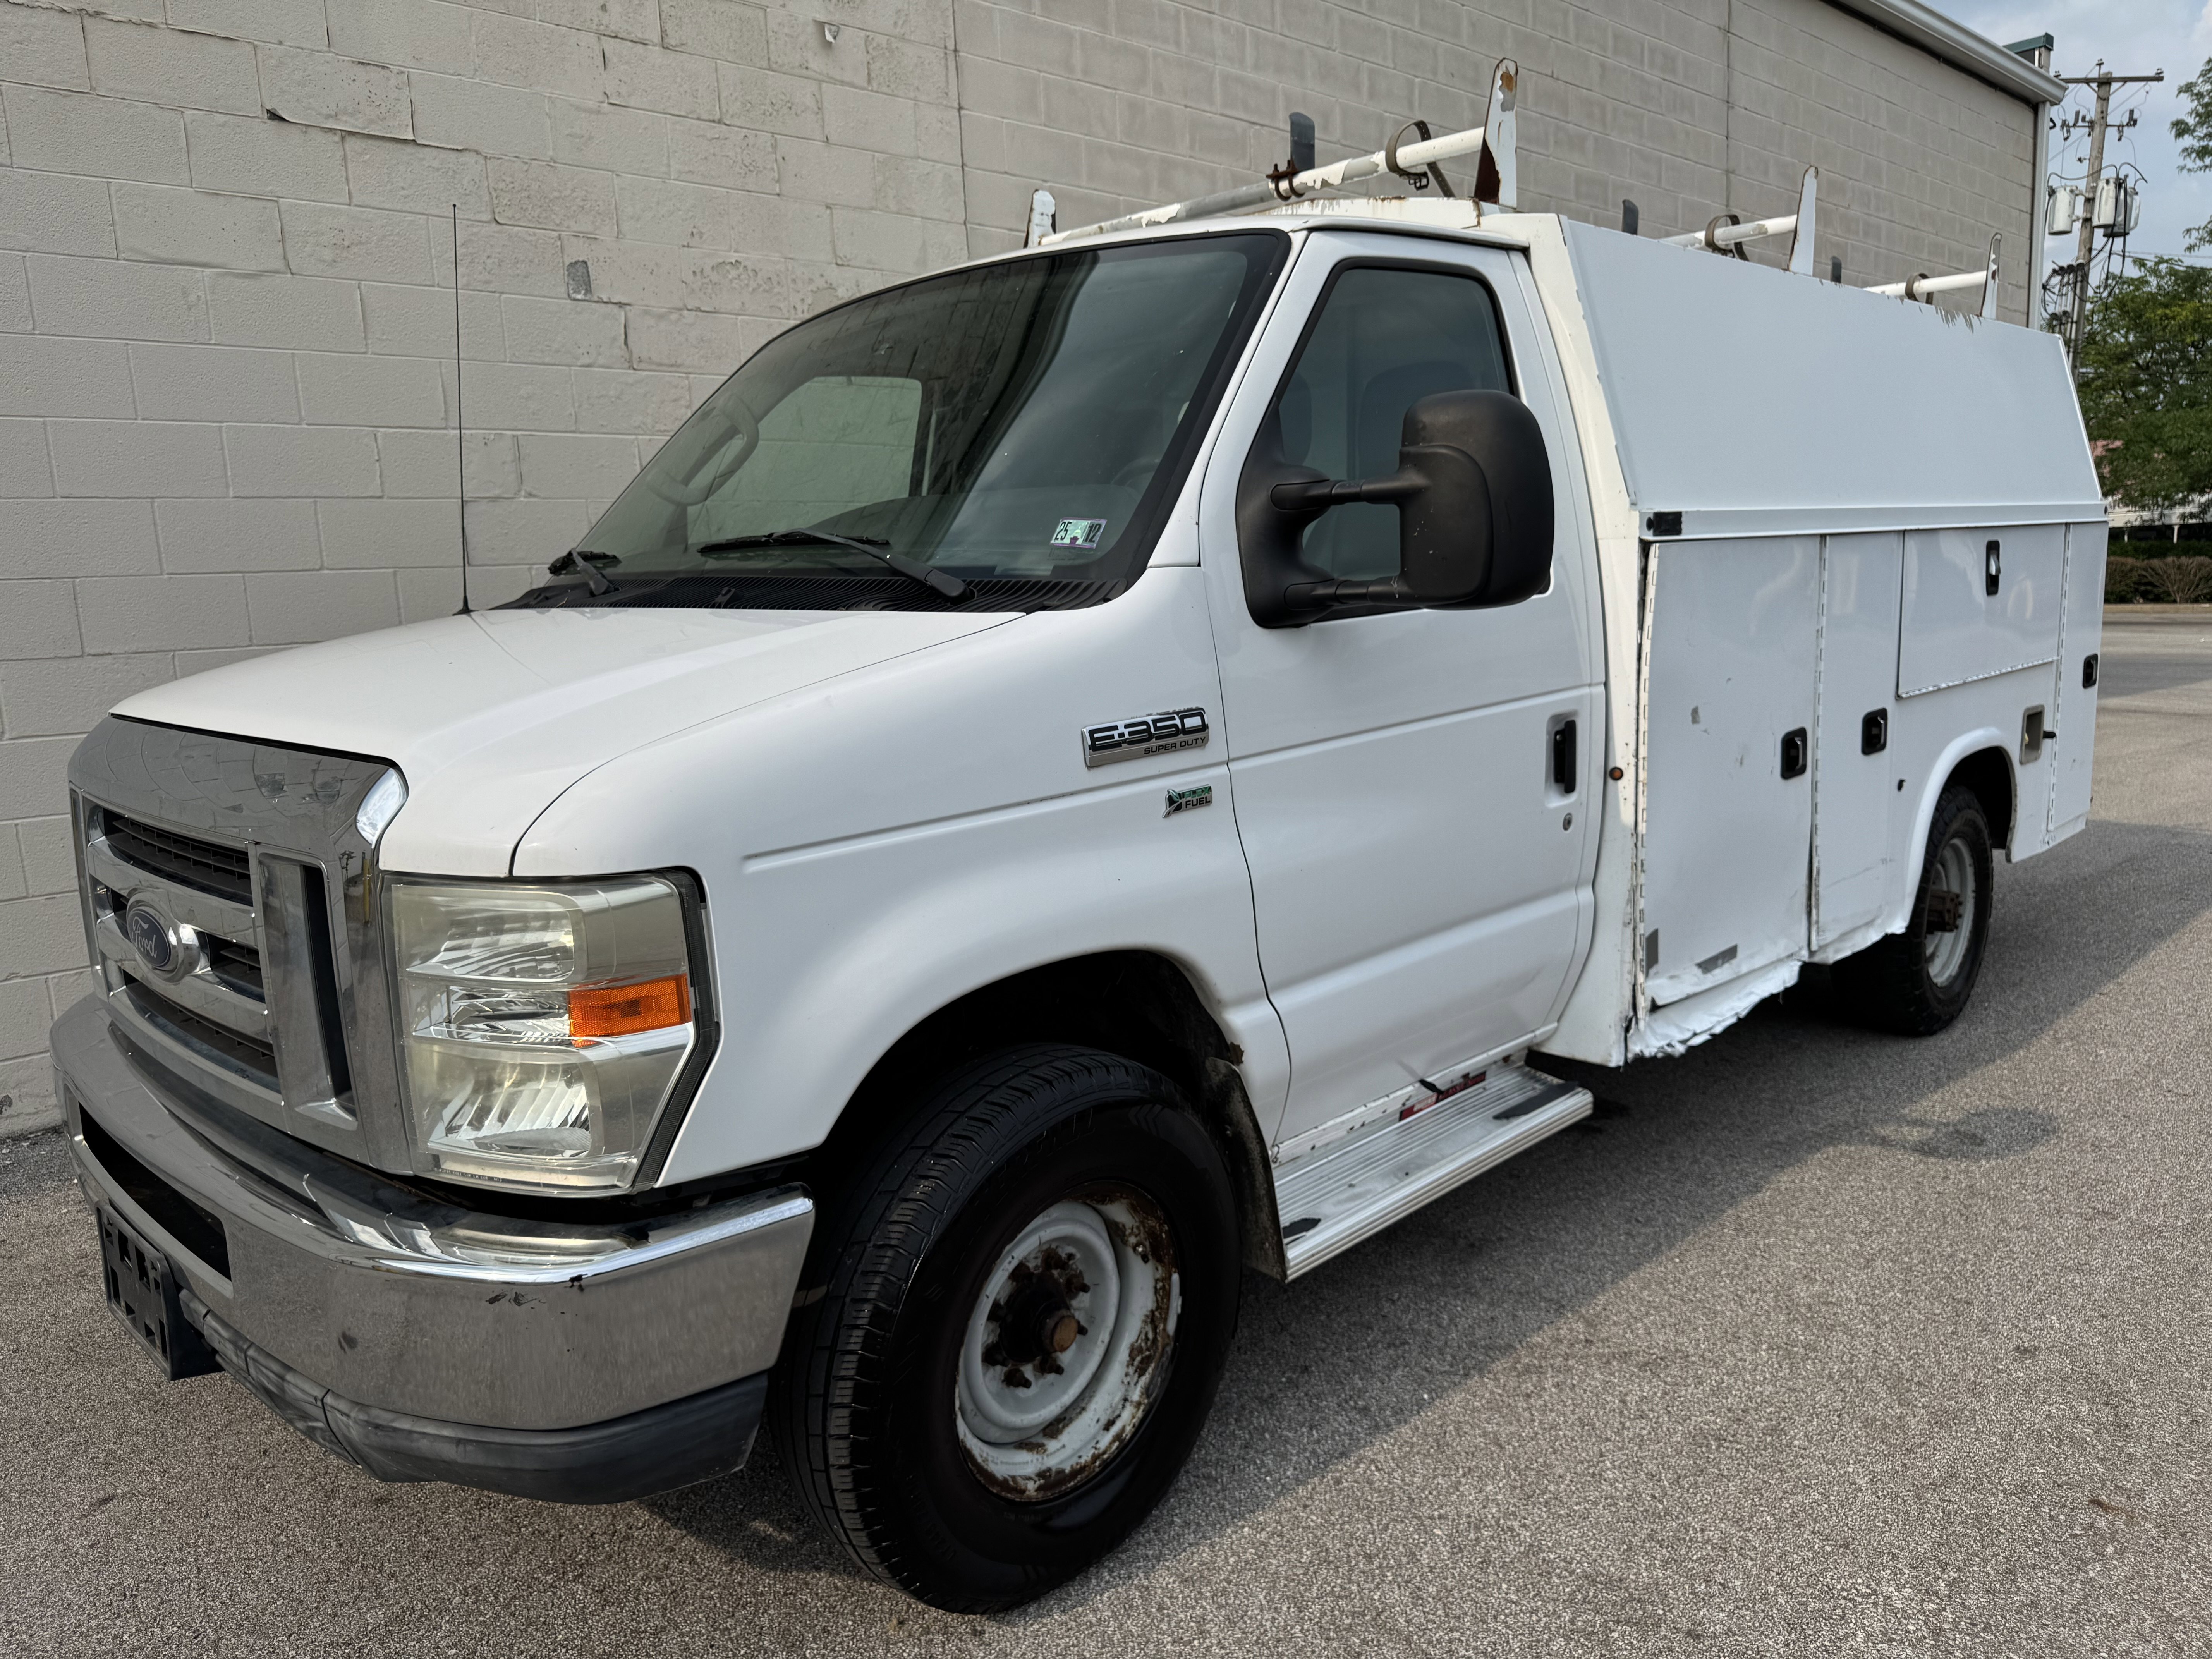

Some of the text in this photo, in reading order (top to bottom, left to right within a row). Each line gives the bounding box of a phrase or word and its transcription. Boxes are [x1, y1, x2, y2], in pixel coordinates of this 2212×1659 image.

[1054, 521, 1072, 541] 25
[1084, 523, 1102, 543] 12
[1144, 736, 1206, 755] SUPER DUTY
[1184, 786, 1211, 799] FLEX
[1185, 797, 1211, 808] FUEL
[132, 916, 157, 958] Ford
